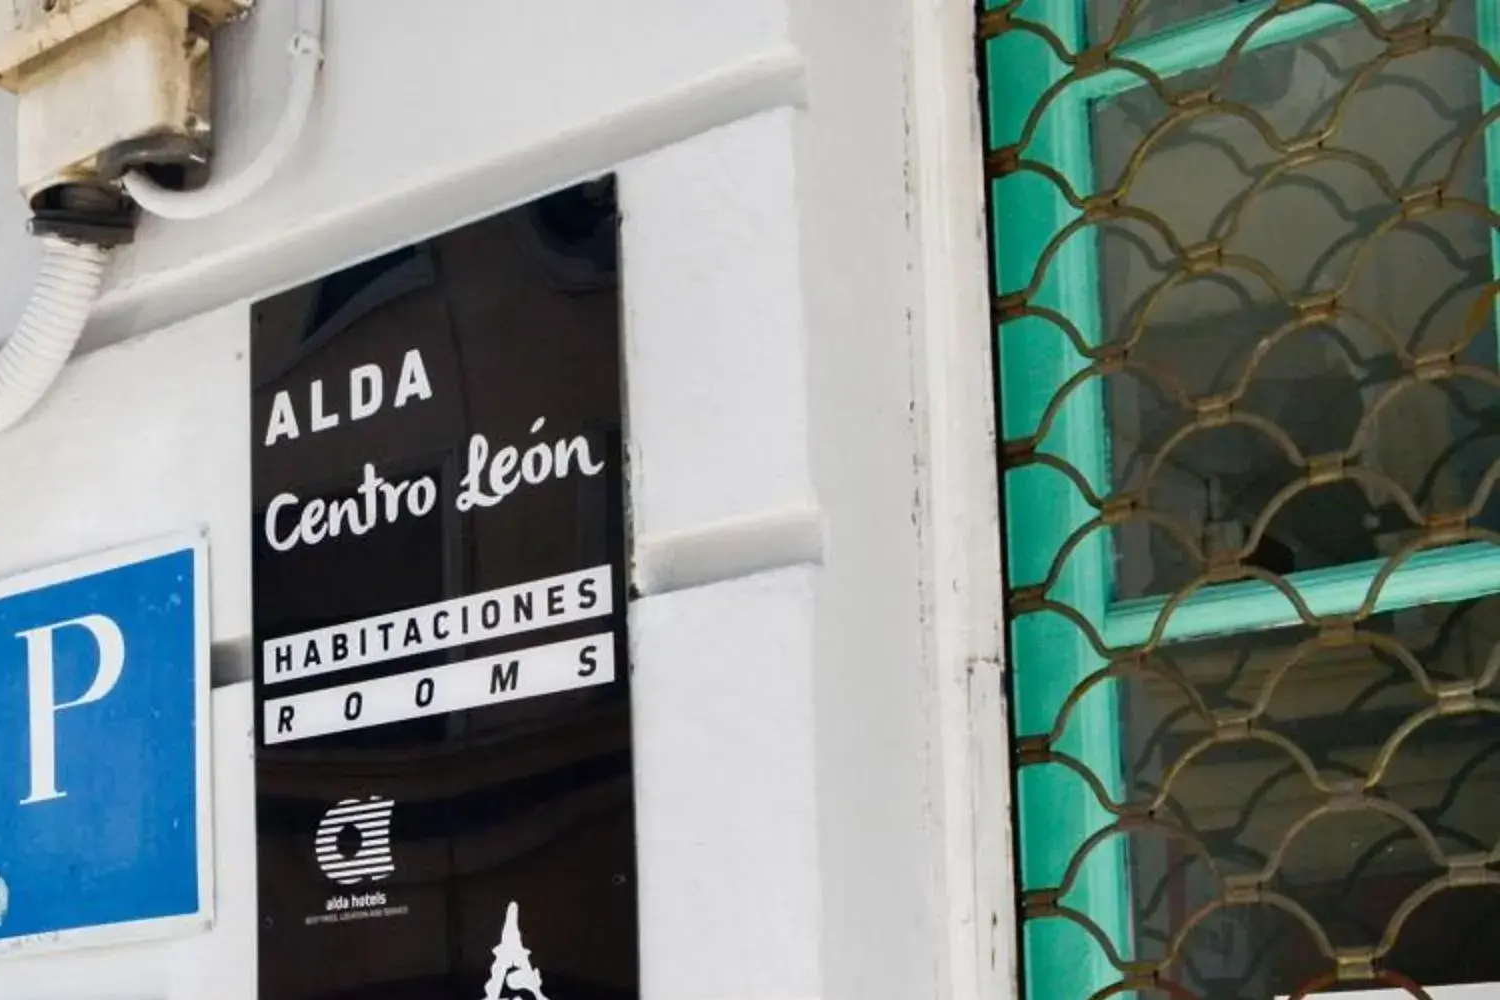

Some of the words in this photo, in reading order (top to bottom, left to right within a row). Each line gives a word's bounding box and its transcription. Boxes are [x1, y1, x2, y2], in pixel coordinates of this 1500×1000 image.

[264, 348, 433, 447] ALDA
[264, 463, 437, 551] Centro
[456, 416, 605, 512] León
[274, 577, 598, 674] HABITACIONES
[15, 613, 125, 805] P
[277, 645, 598, 734] ROOMS
